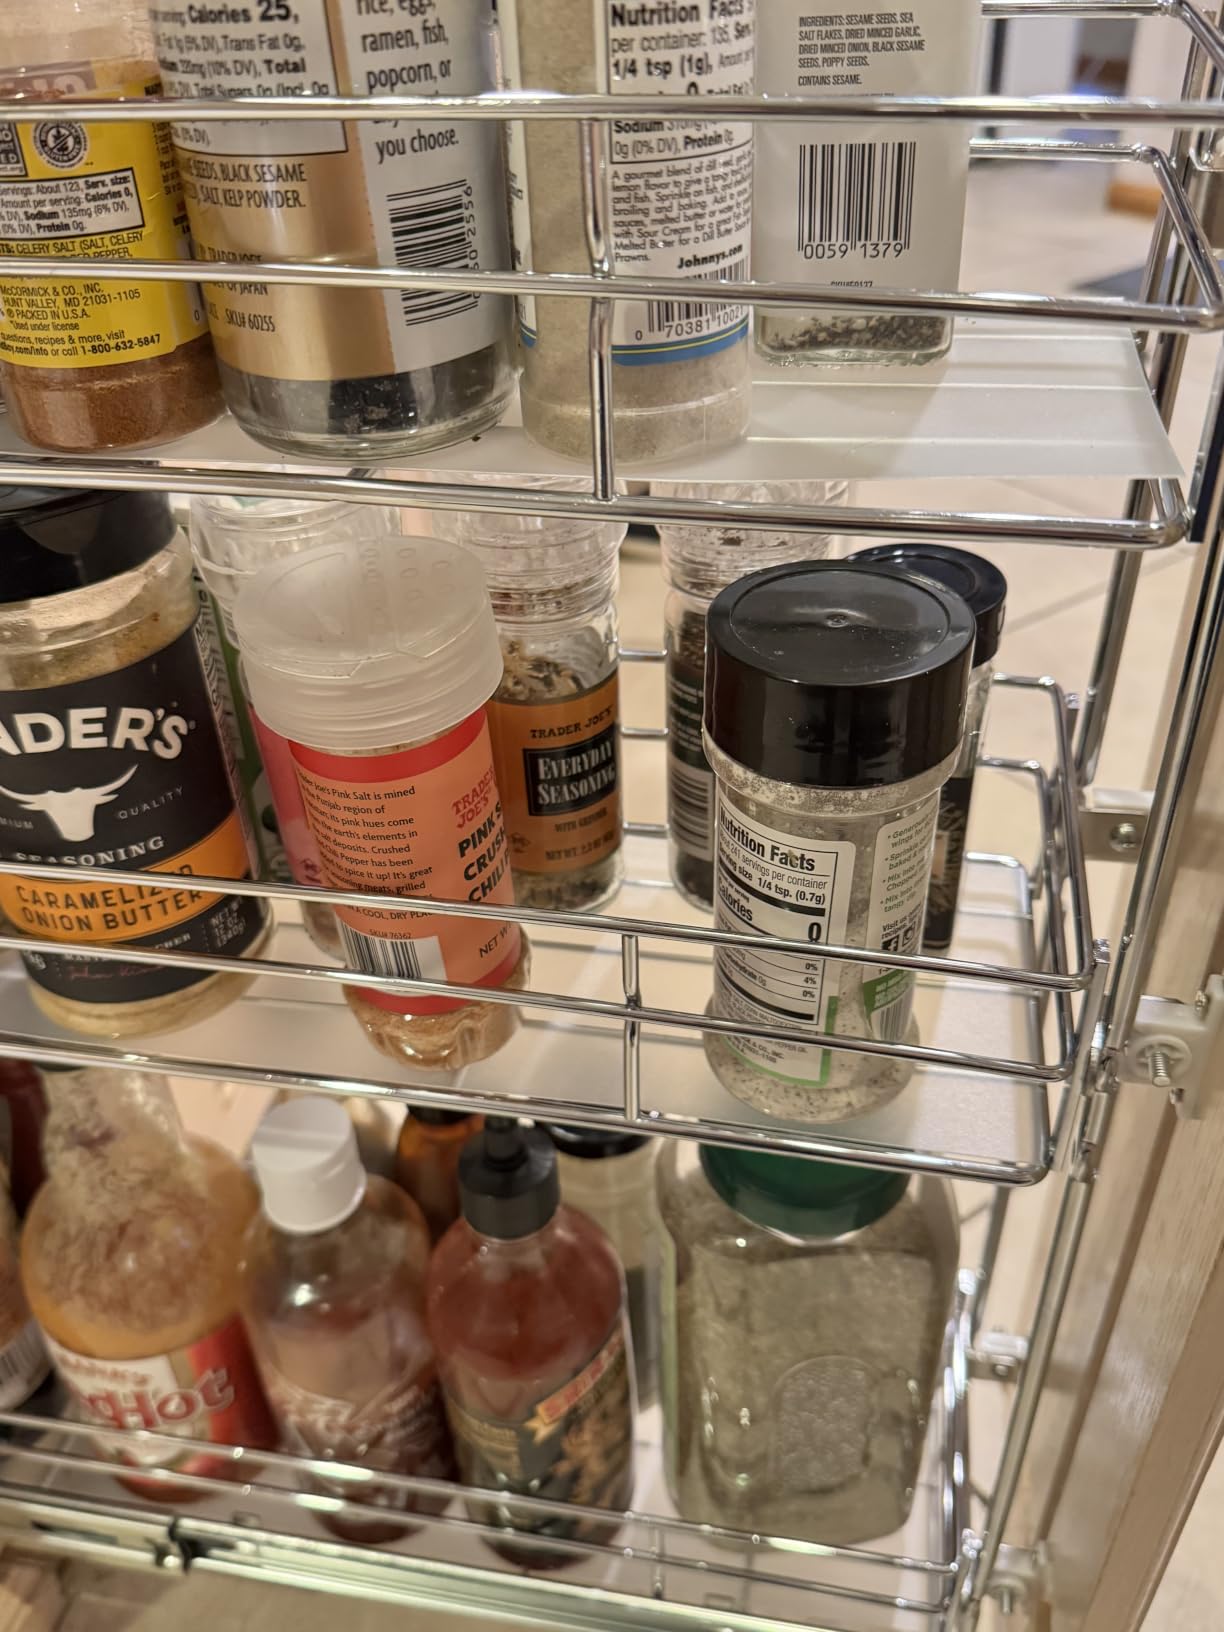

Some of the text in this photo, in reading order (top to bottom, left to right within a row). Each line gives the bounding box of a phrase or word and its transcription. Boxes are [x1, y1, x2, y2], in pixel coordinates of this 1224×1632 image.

[188, 4, 252, 24] Calories
[257, 0, 299, 23] 25,
[611, 1, 700, 28] Nutrition
[799, 12, 914, 28] INGREDIENTS: SESAME SEA
[221, 34, 279, 51] Trans Fat
[361, 18, 449, 53] ramen, fish,
[798, 30, 815, 41] SALT
[816, 29, 845, 41] FLAKES,
[845, 28, 865, 40] DRIED
[866, 27, 893, 39] MINCED
[611, 37, 635, 57] per
[799, 44, 818, 55] DRIED
[820, 43, 846, 54] MINCED
[872, 41, 895, 52] BLACK
[895, 40, 926, 51] SESAME
[263, 57, 306, 74] Total
[612, 57, 672, 80] 1/4 tsp
[822, 56, 846, 68] POPPY
[366, 59, 452, 95] popcorn, or
[798, 74, 862, 87] CONTAINS SESAME.
[614, 120, 664, 134] Sodium
[375, 128, 459, 165] you choose.
[683, 131, 723, 151] Protein
[220, 163, 308, 184] BLACK SESAME
[612, 170, 621, 181] A
[666, 164, 692, 178] blend
[36, 183, 62, 195] About
[110, 174, 131, 186] size:
[33, 199, 48, 211] per
[85, 189, 123, 203] Calories
[223, 188, 307, 209] KELP POWDER.
[612, 187, 704, 206] and on
[24, 210, 60, 222] Sodium
[61, 206, 92, 220] 135mg
[612, 202, 674, 219] broiling and
[36, 222, 71, 233] Protein
[650, 213, 681, 227] melted
[613, 227, 634, 239] with
[637, 226, 658, 239] Sour
[661, 223, 692, 238] Cream
[16, 230, 144, 255] CELERY SALT (SALT, CELERY
[614, 238, 646, 251] Melted
[677, 236, 690, 248] for
[803, 242, 903, 260] 0059 1379
[615, 252, 651, 264] Prawns.
[52, 286, 60, 297] &
[84, 281, 104, 294] INC.
[2, 297, 25, 309] HUNT
[63, 298, 81, 309] MD
[83, 288, 141, 307] 21031-1105
[16, 309, 49, 321] PACKED
[50, 308, 61, 320] IN
[225, 308, 246, 329] SKU#
[248, 313, 275, 333] 60255
[30, 320, 80, 331] under license
[635, 316, 711, 342] 0 70381
[35, 329, 126, 348] recipes & more, visit
[51, 347, 60, 357] or
[61, 345, 78, 357] call
[80, 333, 161, 356] 1-800-632-5847
[530, 721, 582, 740] TRADER
[332, 785, 416, 802] Pink Salt is mined
[538, 764, 616, 807] SEASONING
[117, 785, 184, 820] QUALITY
[343, 804, 386, 816] region of
[457, 788, 490, 830] JOE'S
[341, 816, 415, 828] pink hues come
[334, 825, 418, 842] earth's elements in
[458, 809, 496, 859] PINK
[720, 806, 765, 858] Nutrition
[770, 844, 816, 873] Facts
[16, 836, 165, 867] SEASONING
[333, 837, 410, 854] deposits. Crushed
[340, 852, 414, 867] Pepper has been
[366, 866, 433, 881] it up! It's great
[742, 855, 828, 890] servings per container
[395, 880, 426, 895] grilled
[738, 866, 753, 882] size
[757, 876, 773, 892] 1/4
[775, 884, 793, 899] tsp.
[795, 889, 826, 906] (0.7g)
[22, 887, 203, 932] ONION BUTTER
[210, 909, 229, 928] NET
[390, 910, 407, 921] DRY
[808, 922, 822, 943] 0
[479, 936, 499, 959] NET
[805, 962, 818, 973] 0%
[803, 976, 816, 986] 4%
[802, 988, 815, 1000] 0%
